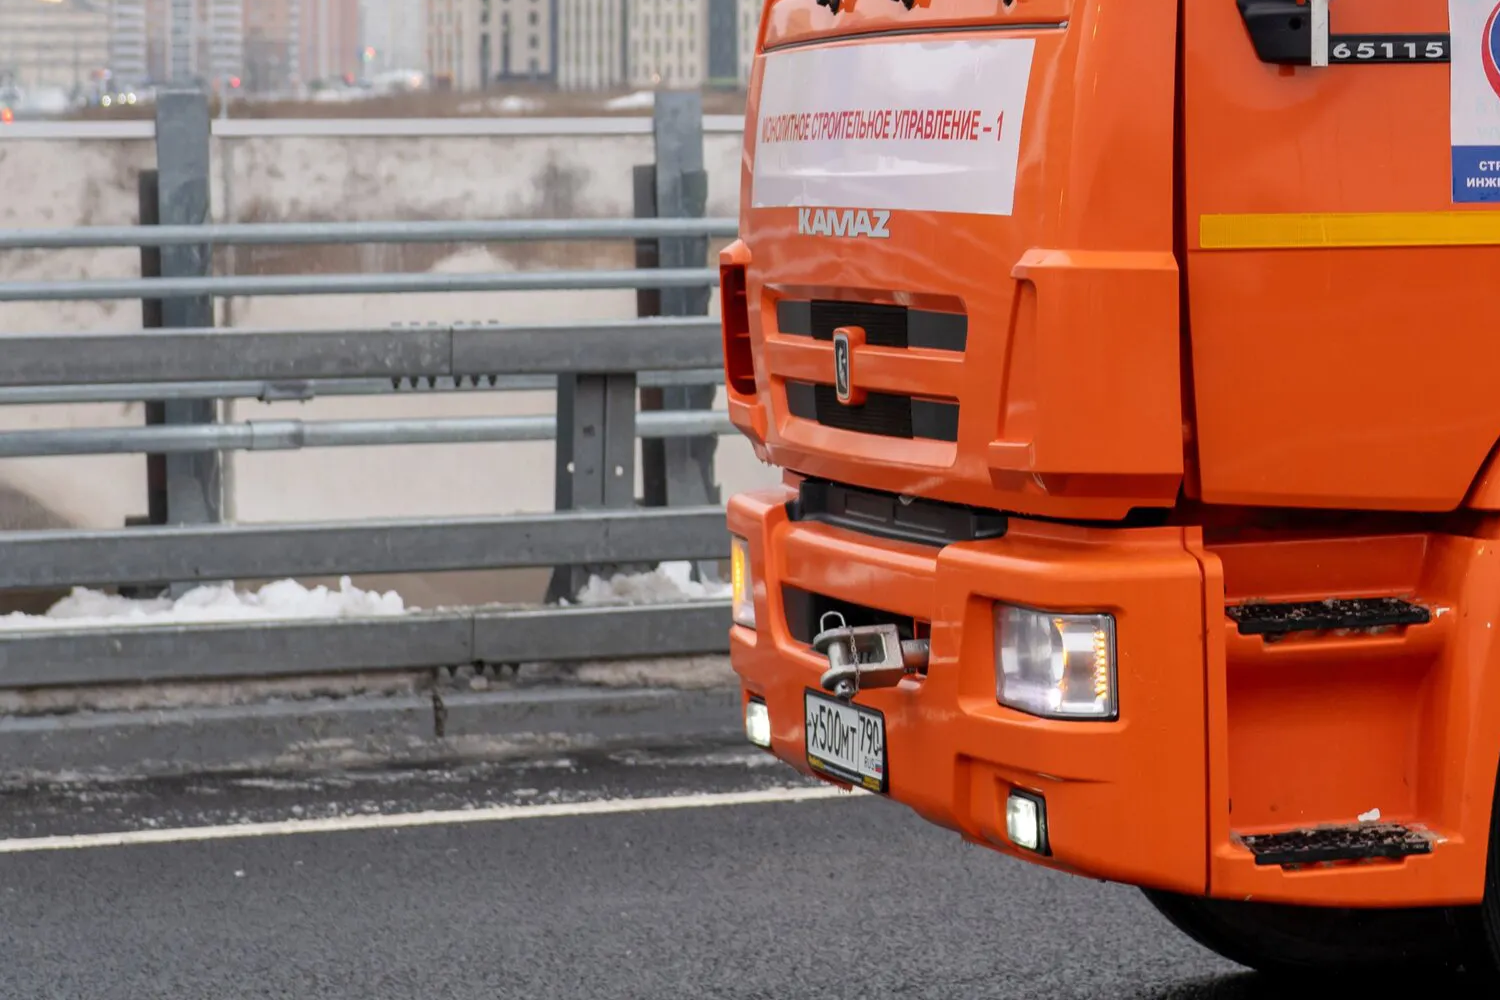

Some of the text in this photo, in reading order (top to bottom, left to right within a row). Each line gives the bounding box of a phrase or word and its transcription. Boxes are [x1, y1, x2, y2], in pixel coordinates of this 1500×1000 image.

[1332, 41, 1444, 59] 65115
[762, 113, 811, 143] МОНОЛИТНОЕ
[811, 110, 891, 141] СТРОИТЕЛЬНОЕ
[892, 110, 981, 141] УПРАВЛЕНИЕ
[798, 207, 891, 238] KAMAZ
[860, 716, 880, 757] 790
[864, 755, 875, 771] RUS
